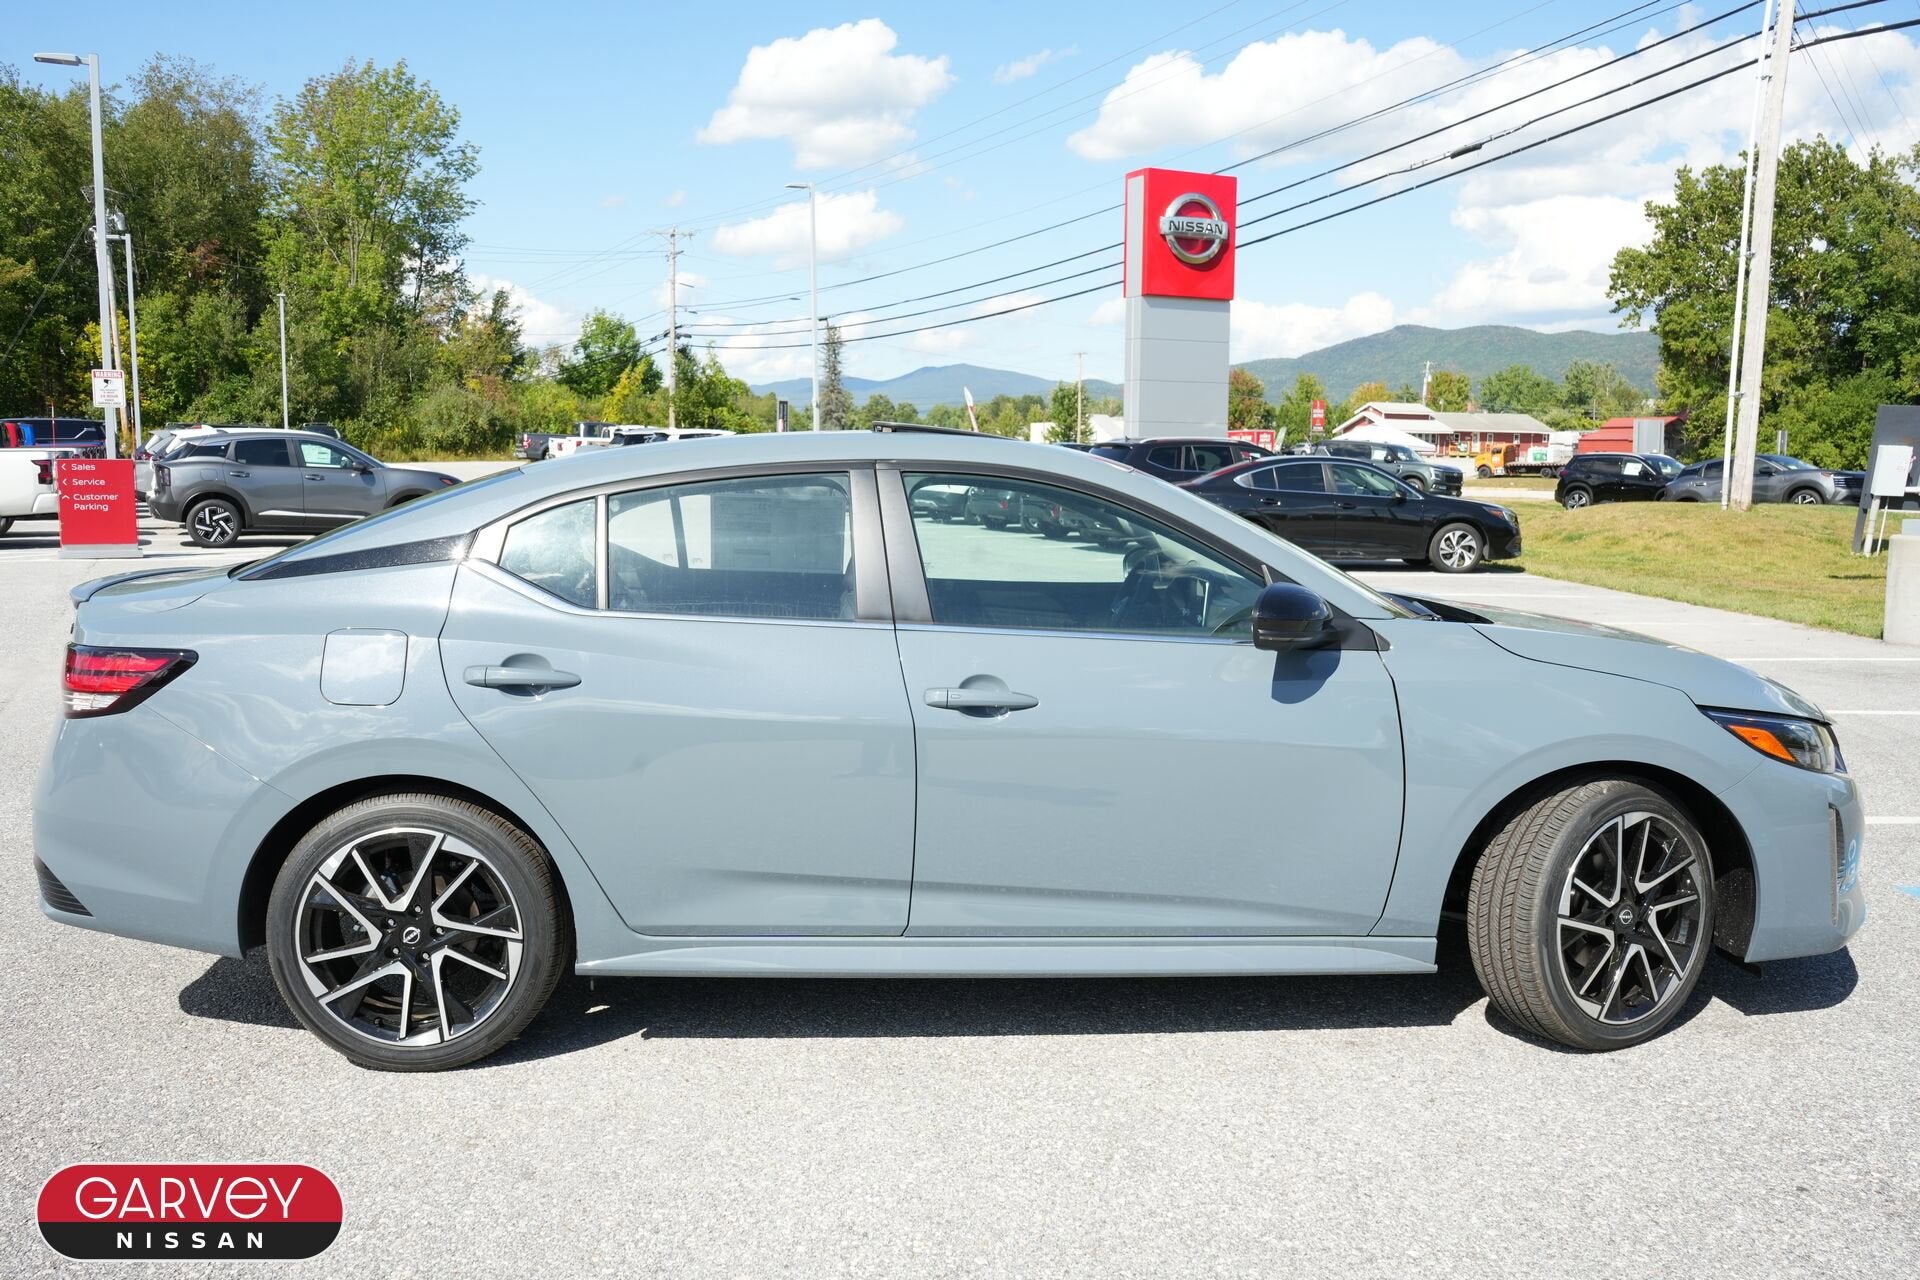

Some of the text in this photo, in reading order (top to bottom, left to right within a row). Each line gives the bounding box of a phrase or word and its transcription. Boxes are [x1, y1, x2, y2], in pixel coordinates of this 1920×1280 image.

[1168, 220, 1223, 235] NISSAN
[71, 463, 96, 471] Sales
[72, 478, 106, 486] Service
[73, 493, 119, 501] Customer
[74, 503, 109, 511] Parking
